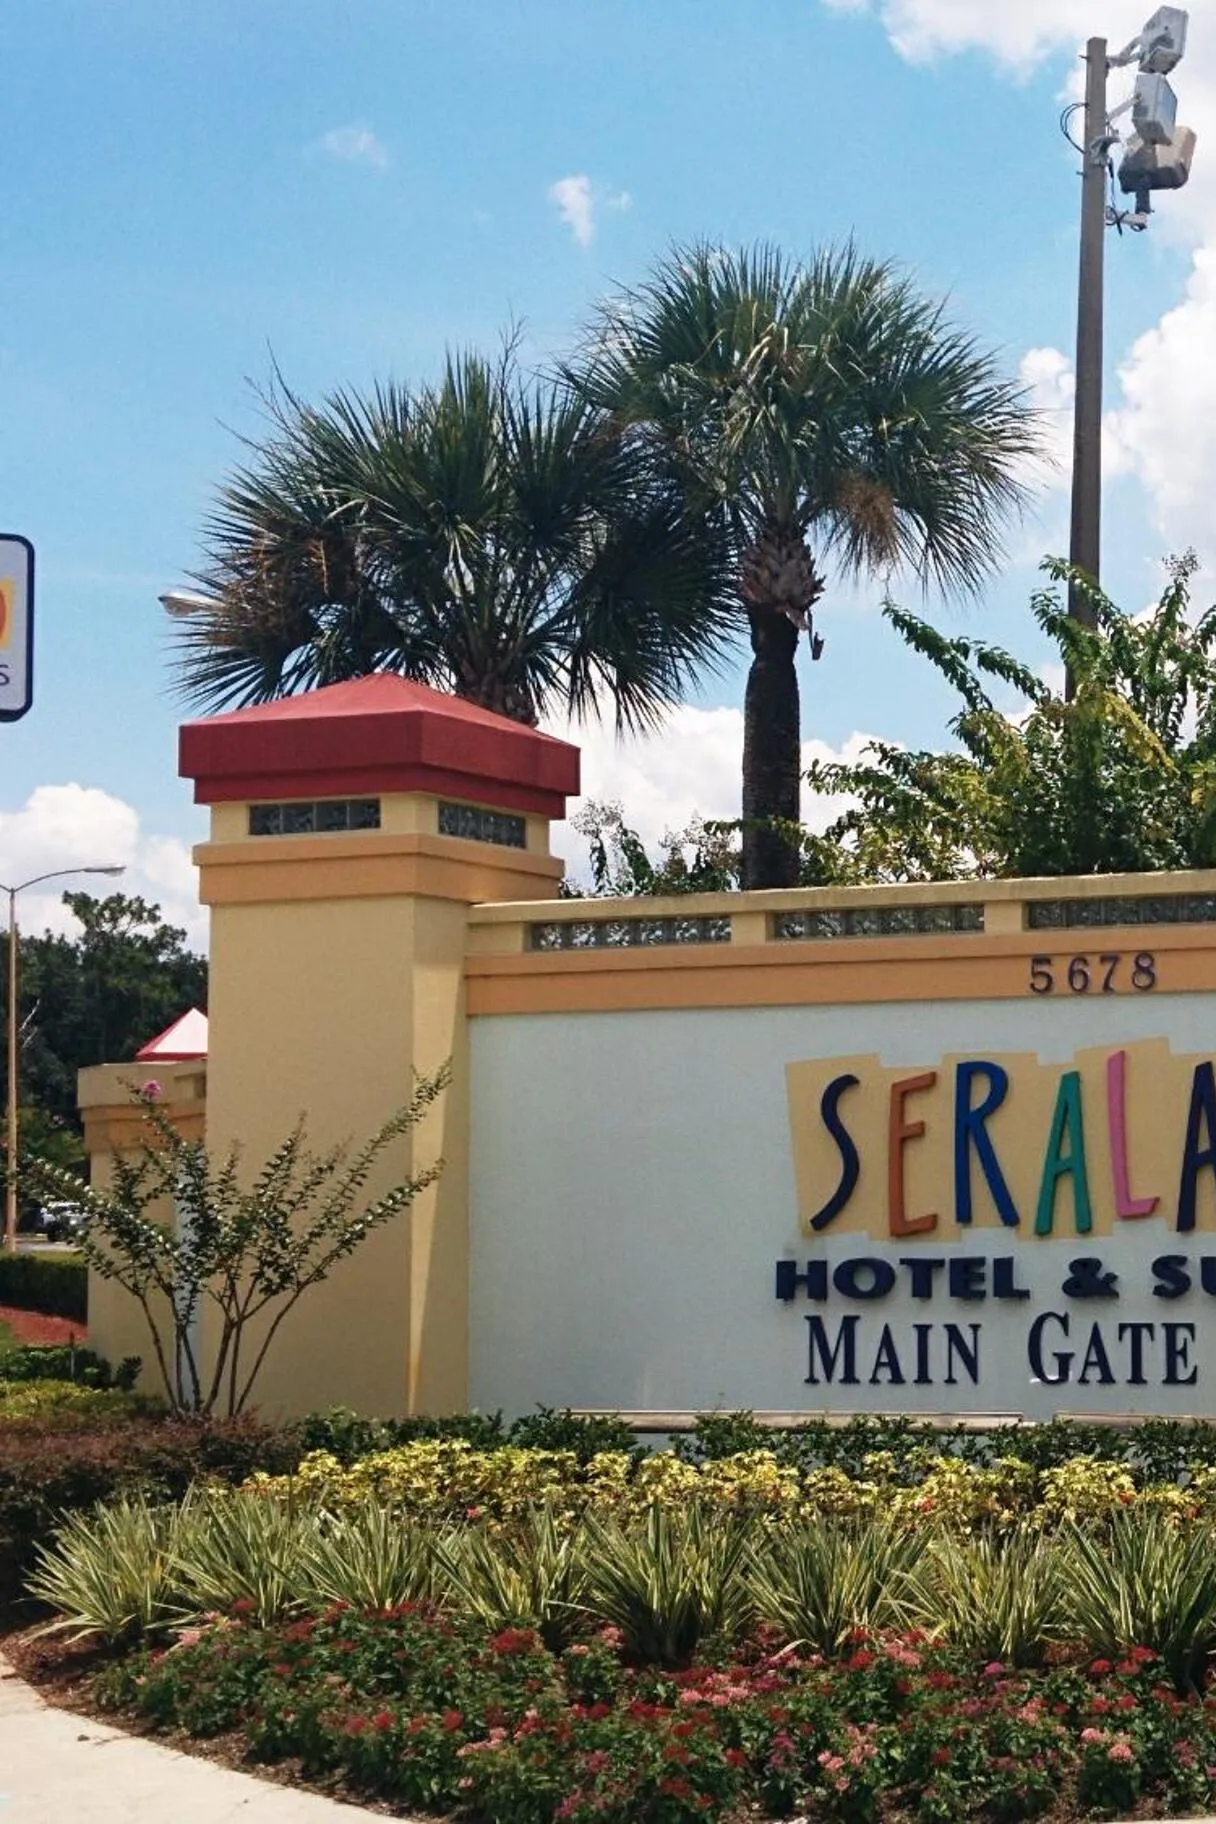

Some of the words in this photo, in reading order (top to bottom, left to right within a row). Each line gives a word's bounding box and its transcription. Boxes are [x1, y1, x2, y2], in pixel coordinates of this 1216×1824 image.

[1030, 953, 1157, 994] 5678
[775, 1256, 1030, 1301] HOTEL
[1062, 1257, 1119, 1299] &
[804, 1315, 981, 1384] MAIN
[1028, 1311, 1198, 1386] GATE
